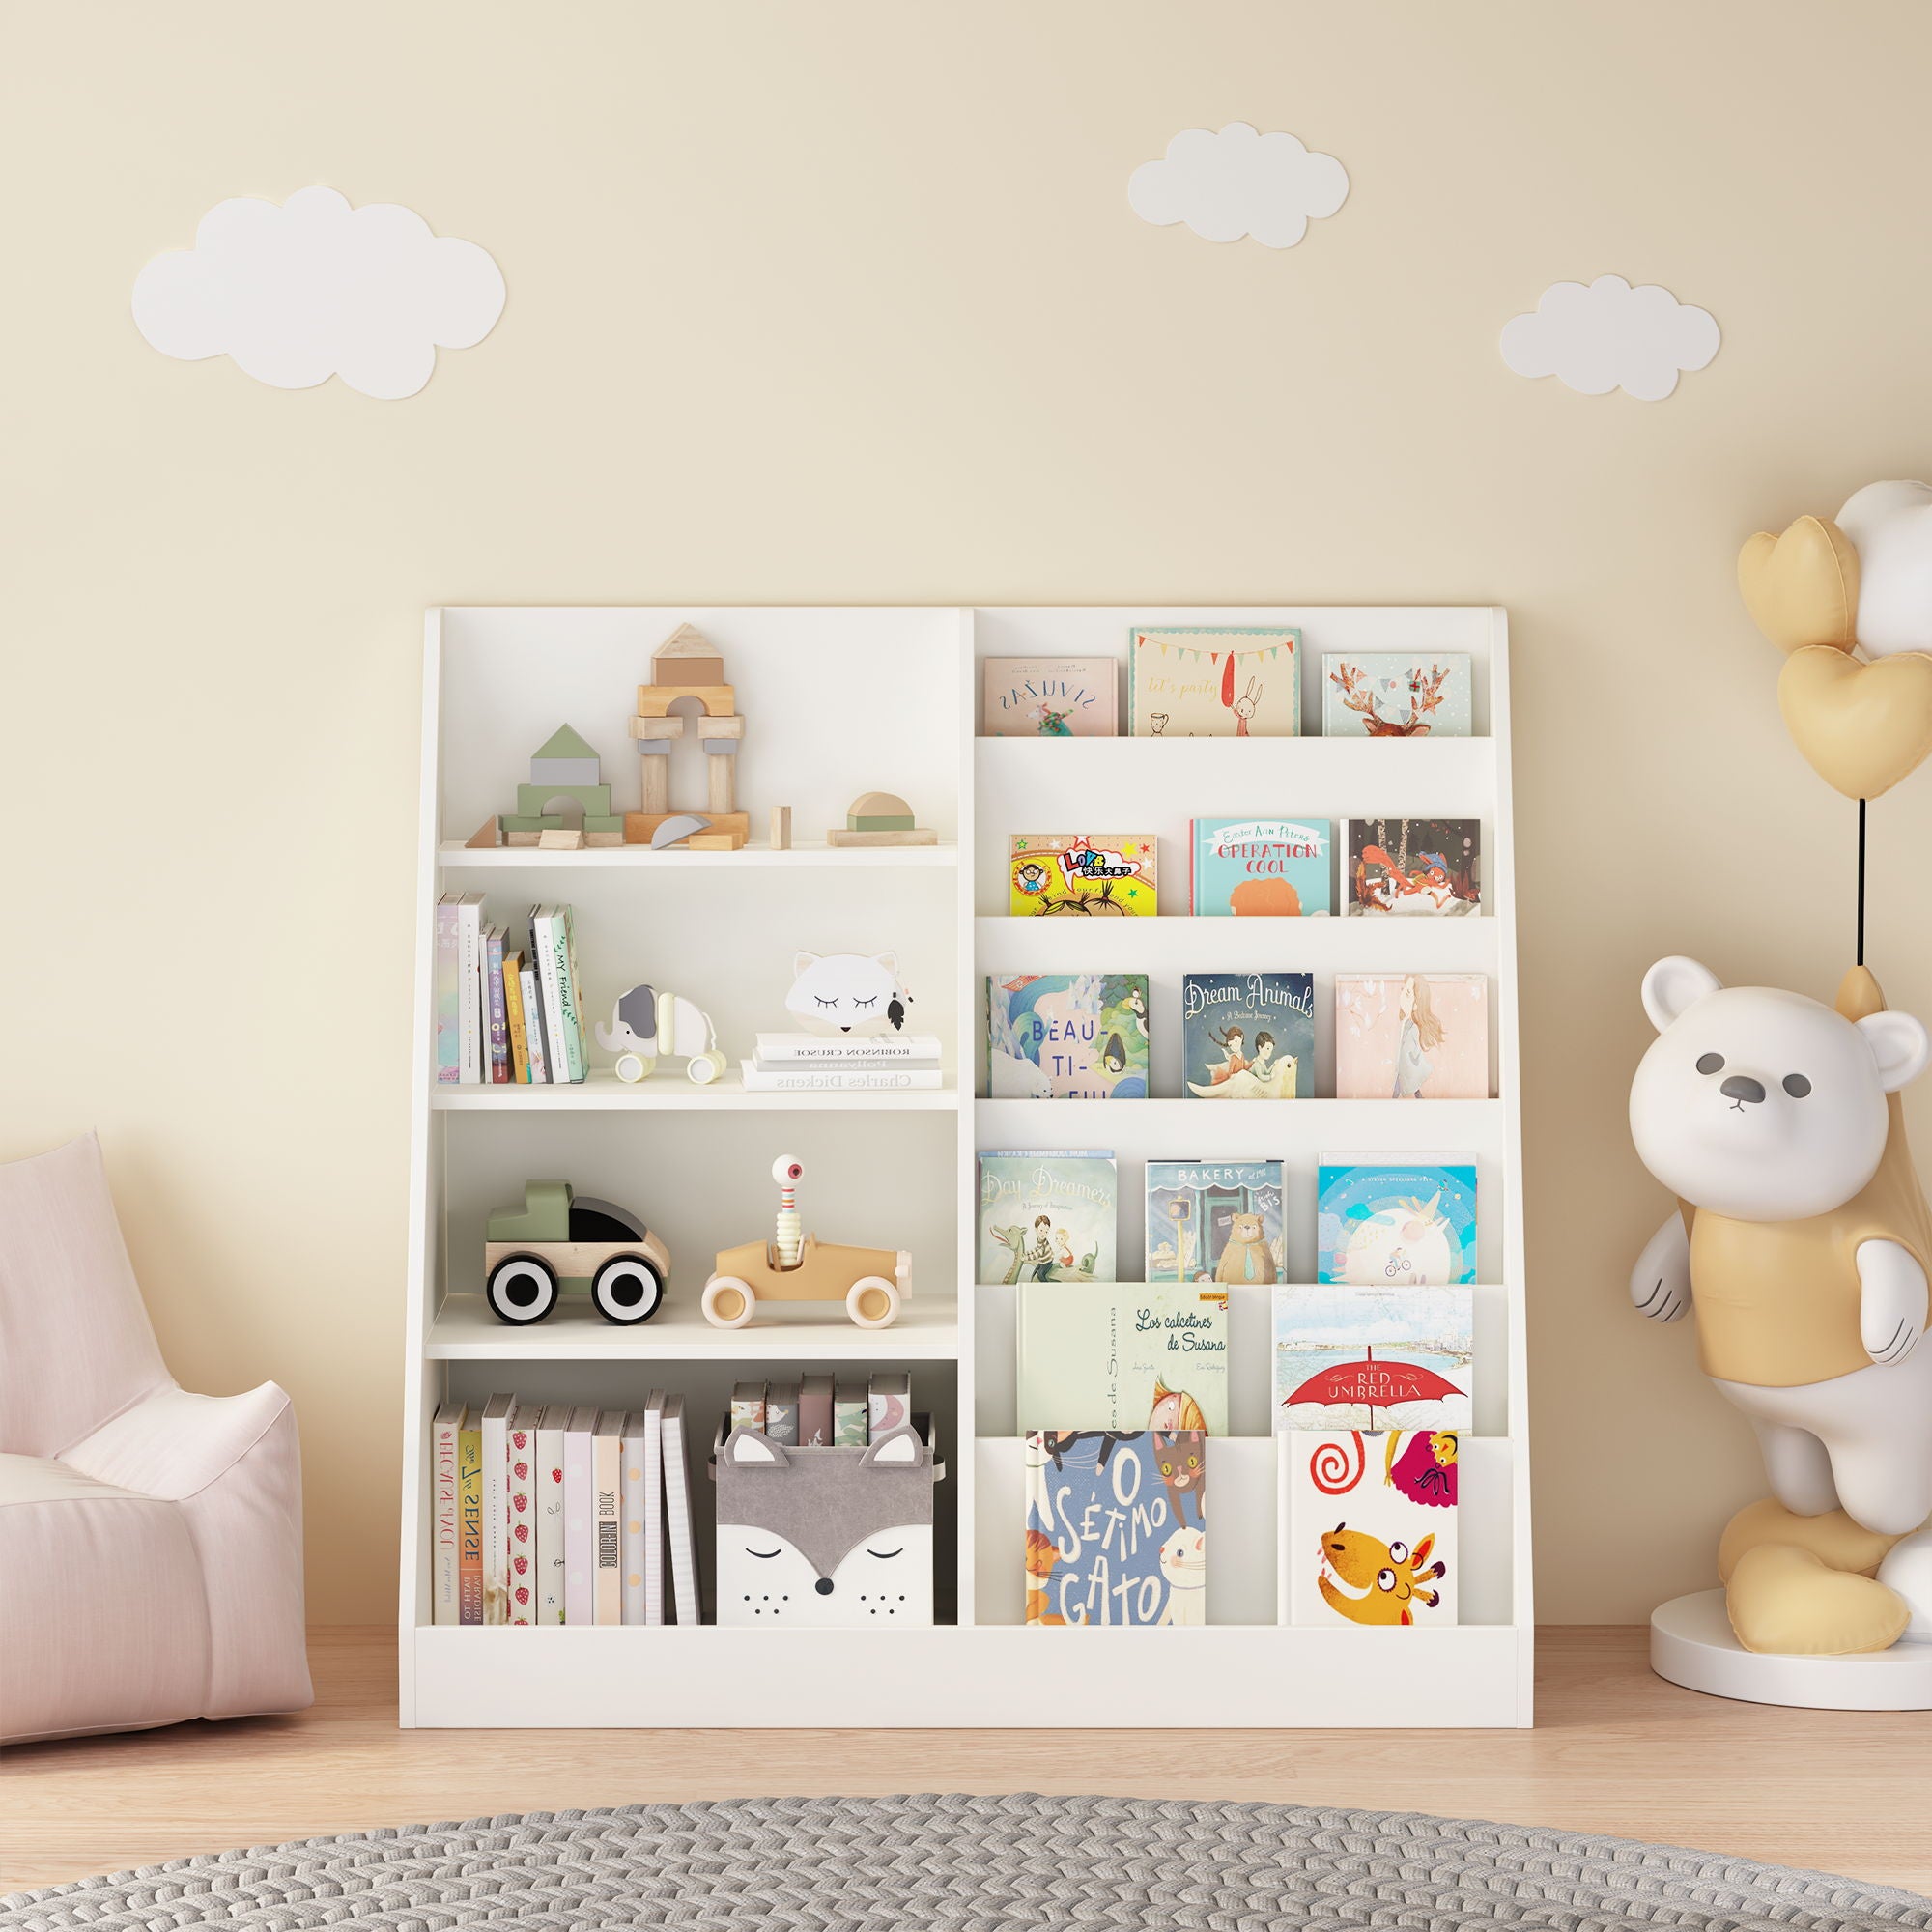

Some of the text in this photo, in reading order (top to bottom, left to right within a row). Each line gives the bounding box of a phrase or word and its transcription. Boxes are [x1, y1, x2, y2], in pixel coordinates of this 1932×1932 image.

[1179, 679, 1217, 702] party
[1217, 843, 1318, 858] OPERATION
[1246, 860, 1289, 873] COOL
[556, 954, 570, 1007] MY Friend
[1184, 973, 1313, 1019] Dream Animals
[1051, 1056, 1087, 1076] TI-
[981, 1165, 1111, 1207] Day Dreamers
[1178, 1168, 1244, 1181] BAKERY
[1135, 1308, 1213, 1332] Los calcetines
[1167, 1332, 1226, 1352] de Susana
[1357, 1372, 1391, 1384] RED
[1328, 1384, 1422, 1400] UMBRELLA
[1112, 1447, 1141, 1506] O
[599, 1492, 615, 1516] BOOK
[1060, 1555, 1161, 1625] GATO
